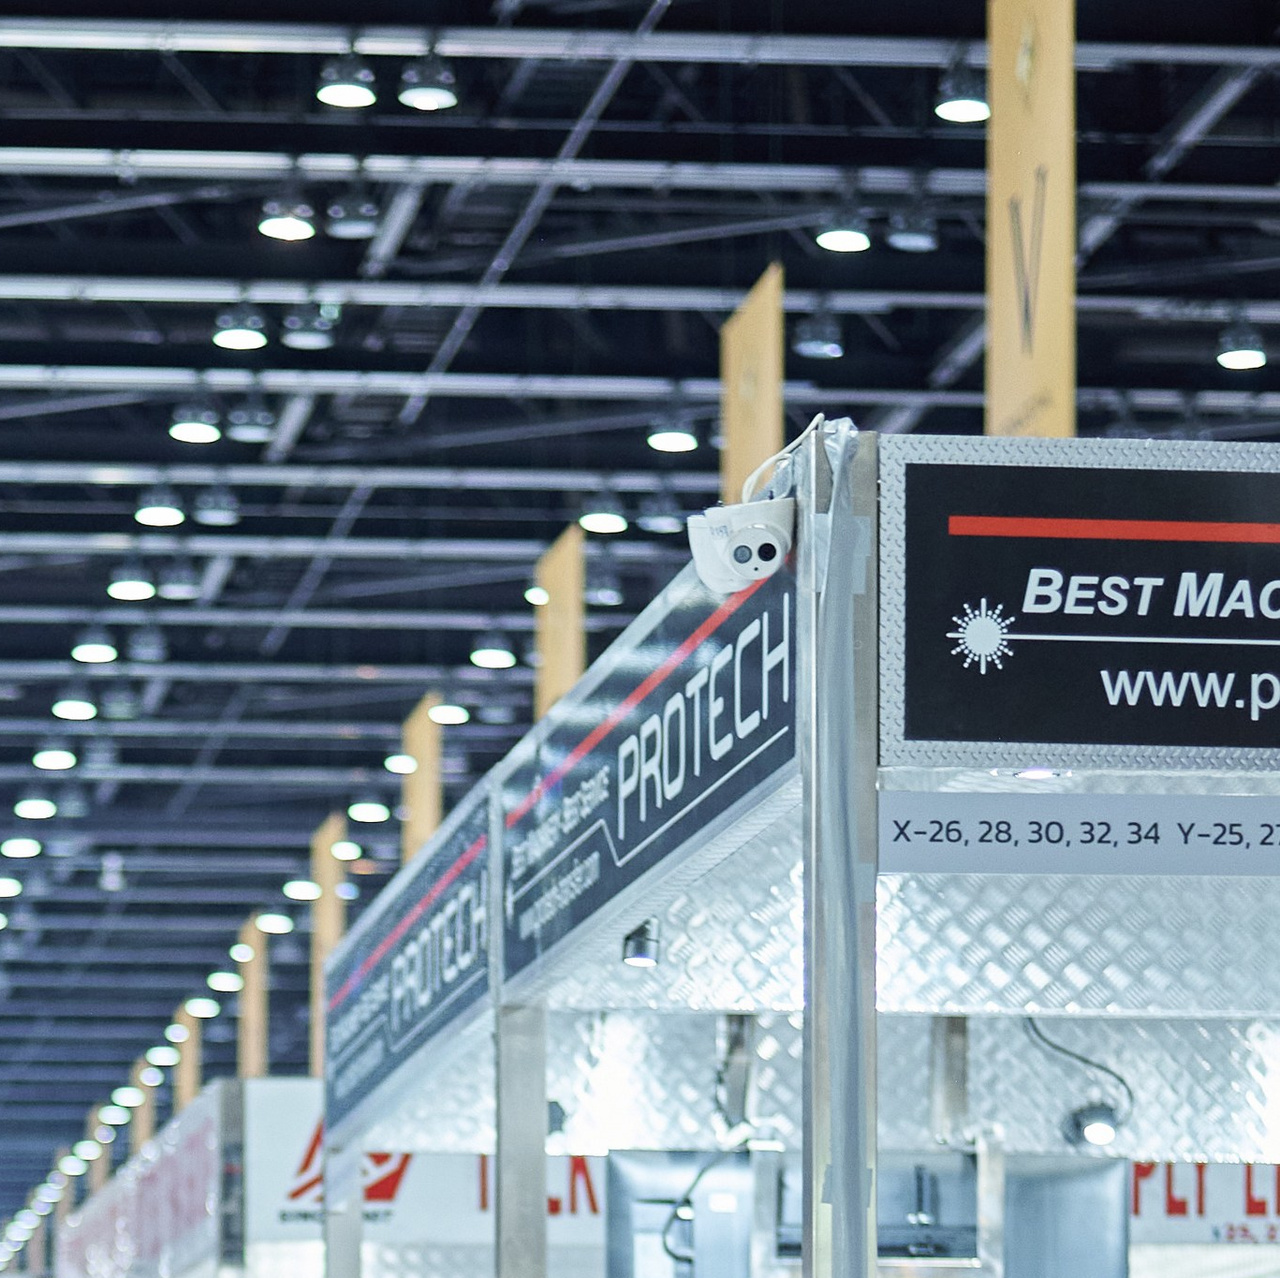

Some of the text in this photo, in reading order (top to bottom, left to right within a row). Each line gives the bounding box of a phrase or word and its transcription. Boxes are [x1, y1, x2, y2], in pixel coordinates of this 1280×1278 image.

[1021, 567, 1165, 616] BEST
[617, 591, 790, 841] PROTECH
[1099, 669, 1280, 721] www.p
[892, 819, 1280, 850] X-26, 28, 30, 32, 34 Y-25, 2
[389, 867, 488, 1033] PROTECH
